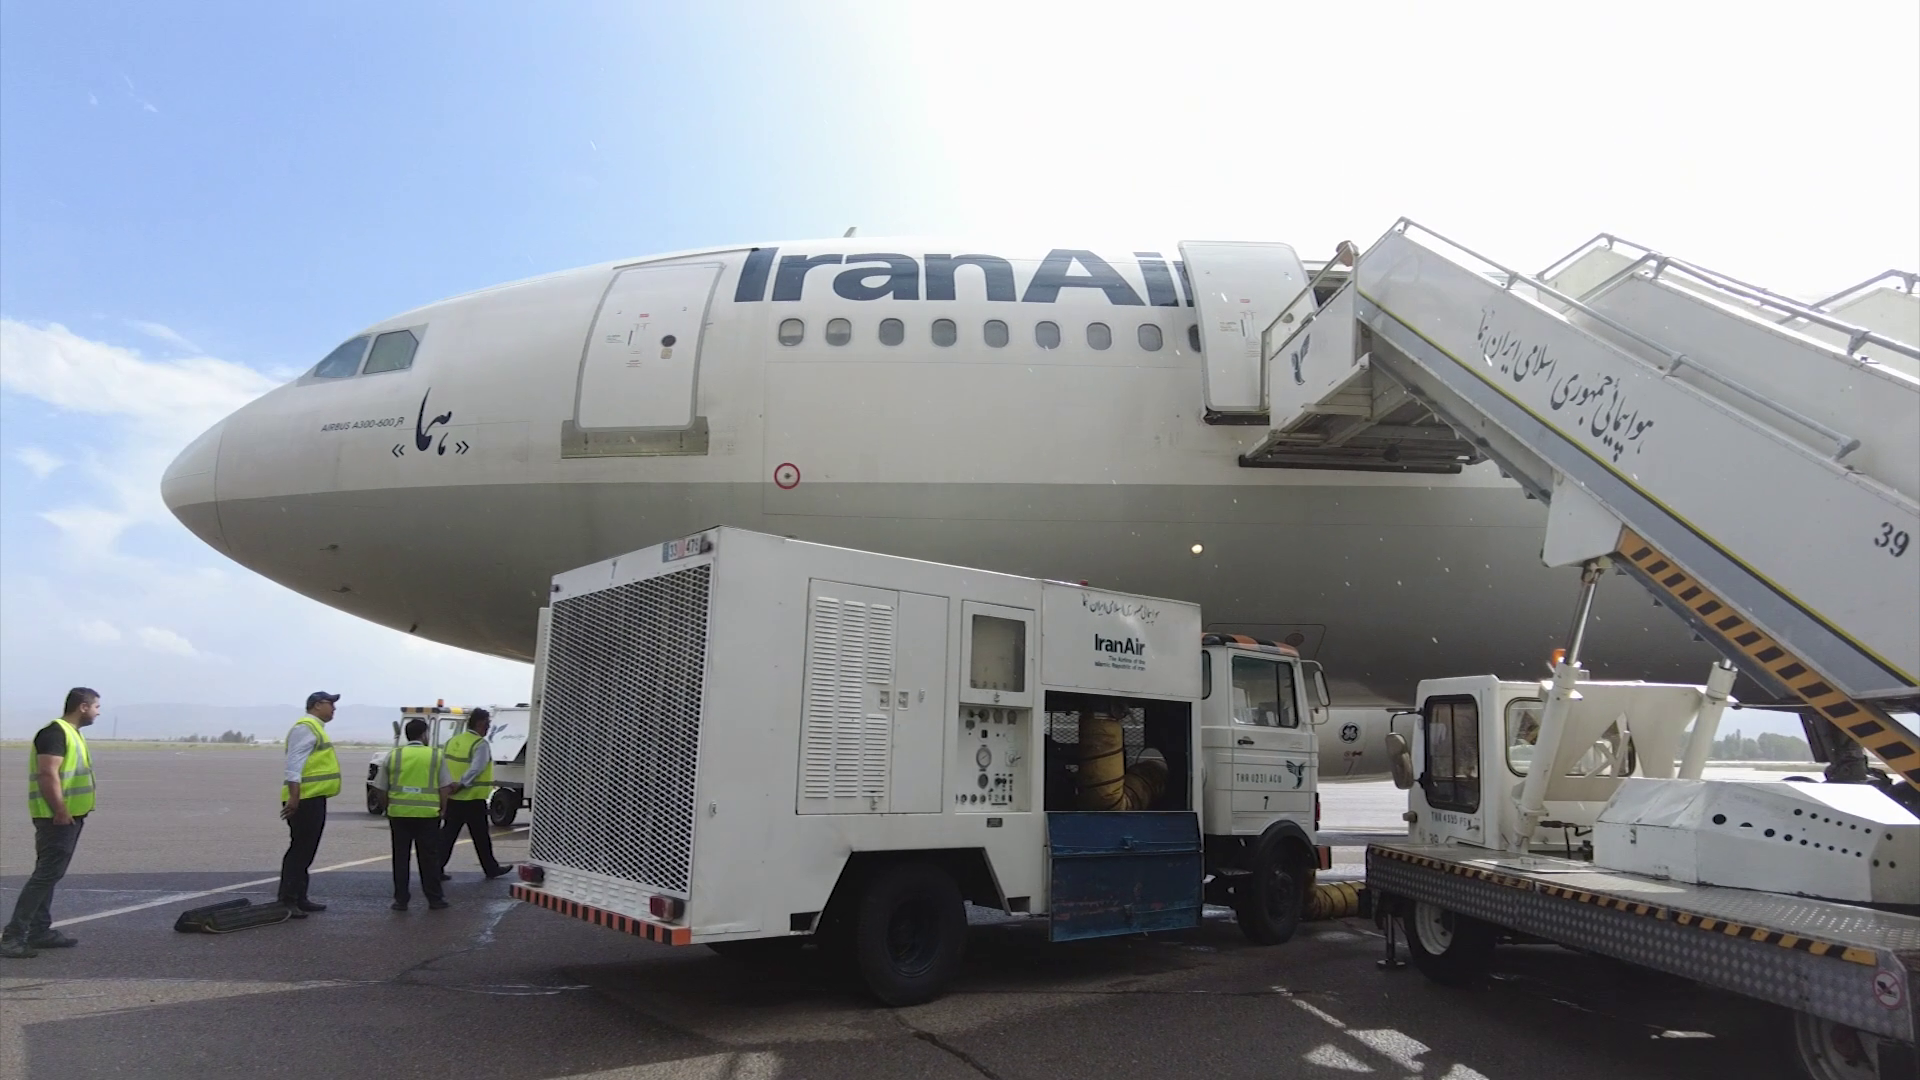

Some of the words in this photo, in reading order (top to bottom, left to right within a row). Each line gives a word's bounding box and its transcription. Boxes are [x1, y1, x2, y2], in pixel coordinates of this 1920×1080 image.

[320, 421, 351, 432] AIRBUS
[1874, 521, 1910, 558] 39
[1094, 633, 1146, 656] IranAir
